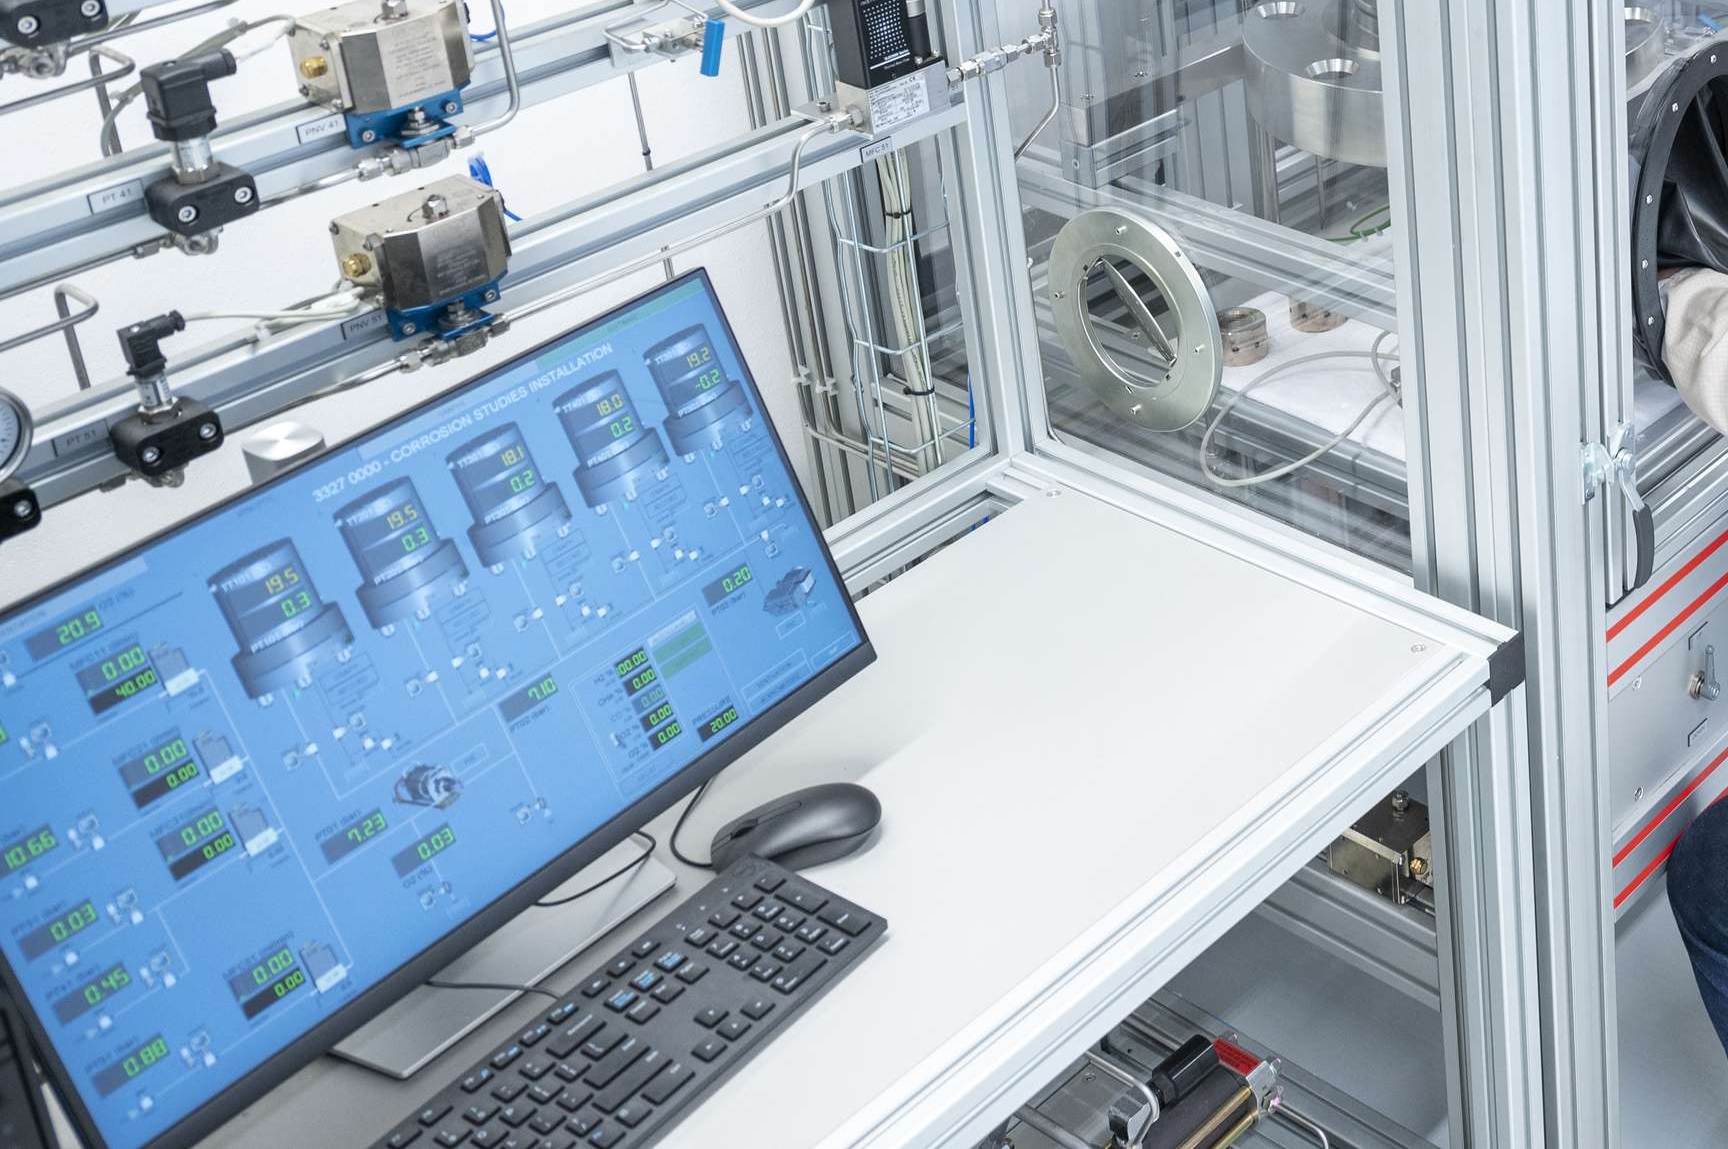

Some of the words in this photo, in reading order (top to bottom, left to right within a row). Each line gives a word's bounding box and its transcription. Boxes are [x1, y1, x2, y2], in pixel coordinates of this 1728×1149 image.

[685, 346, 712, 368] 19.2
[312, 477, 347, 503] 3327
[389, 413, 473, 462] CORROSION
[472, 386, 527, 420] STUDIES
[527, 342, 613, 392] INSTALLATION
[609, 416, 635, 438] 0.2
[500, 445, 525, 466] 18.1
[509, 470, 535, 492] 0.2
[386, 504, 418, 529] 19.5
[401, 527, 429, 550] 0.3
[264, 565, 300, 594] 19.5
[721, 566, 752, 592] 0.20
[280, 591, 312, 617] 0.3
[55, 610, 101, 645] 20.9
[100, 646, 146, 680] 0.00
[114, 669, 157, 699] 40.00
[632, 669, 656, 688] 0.00
[640, 687, 664, 706] 0.00
[649, 705, 673, 724] 0.00
[708, 708, 738, 732] 20.00
[657, 723, 680, 742] 0.00
[142, 739, 187, 774] 0.00
[165, 762, 198, 788] 0.00
[179, 810, 224, 845] 0.00
[345, 812, 387, 844] 7.23
[202, 833, 235, 859] 0.00
[414, 827, 456, 859] 0.03
[48, 903, 98, 941] 0.03
[249, 948, 296, 985] 0.00
[81, 966, 131, 1005] 0.45
[272, 970, 305, 996] 0.00
